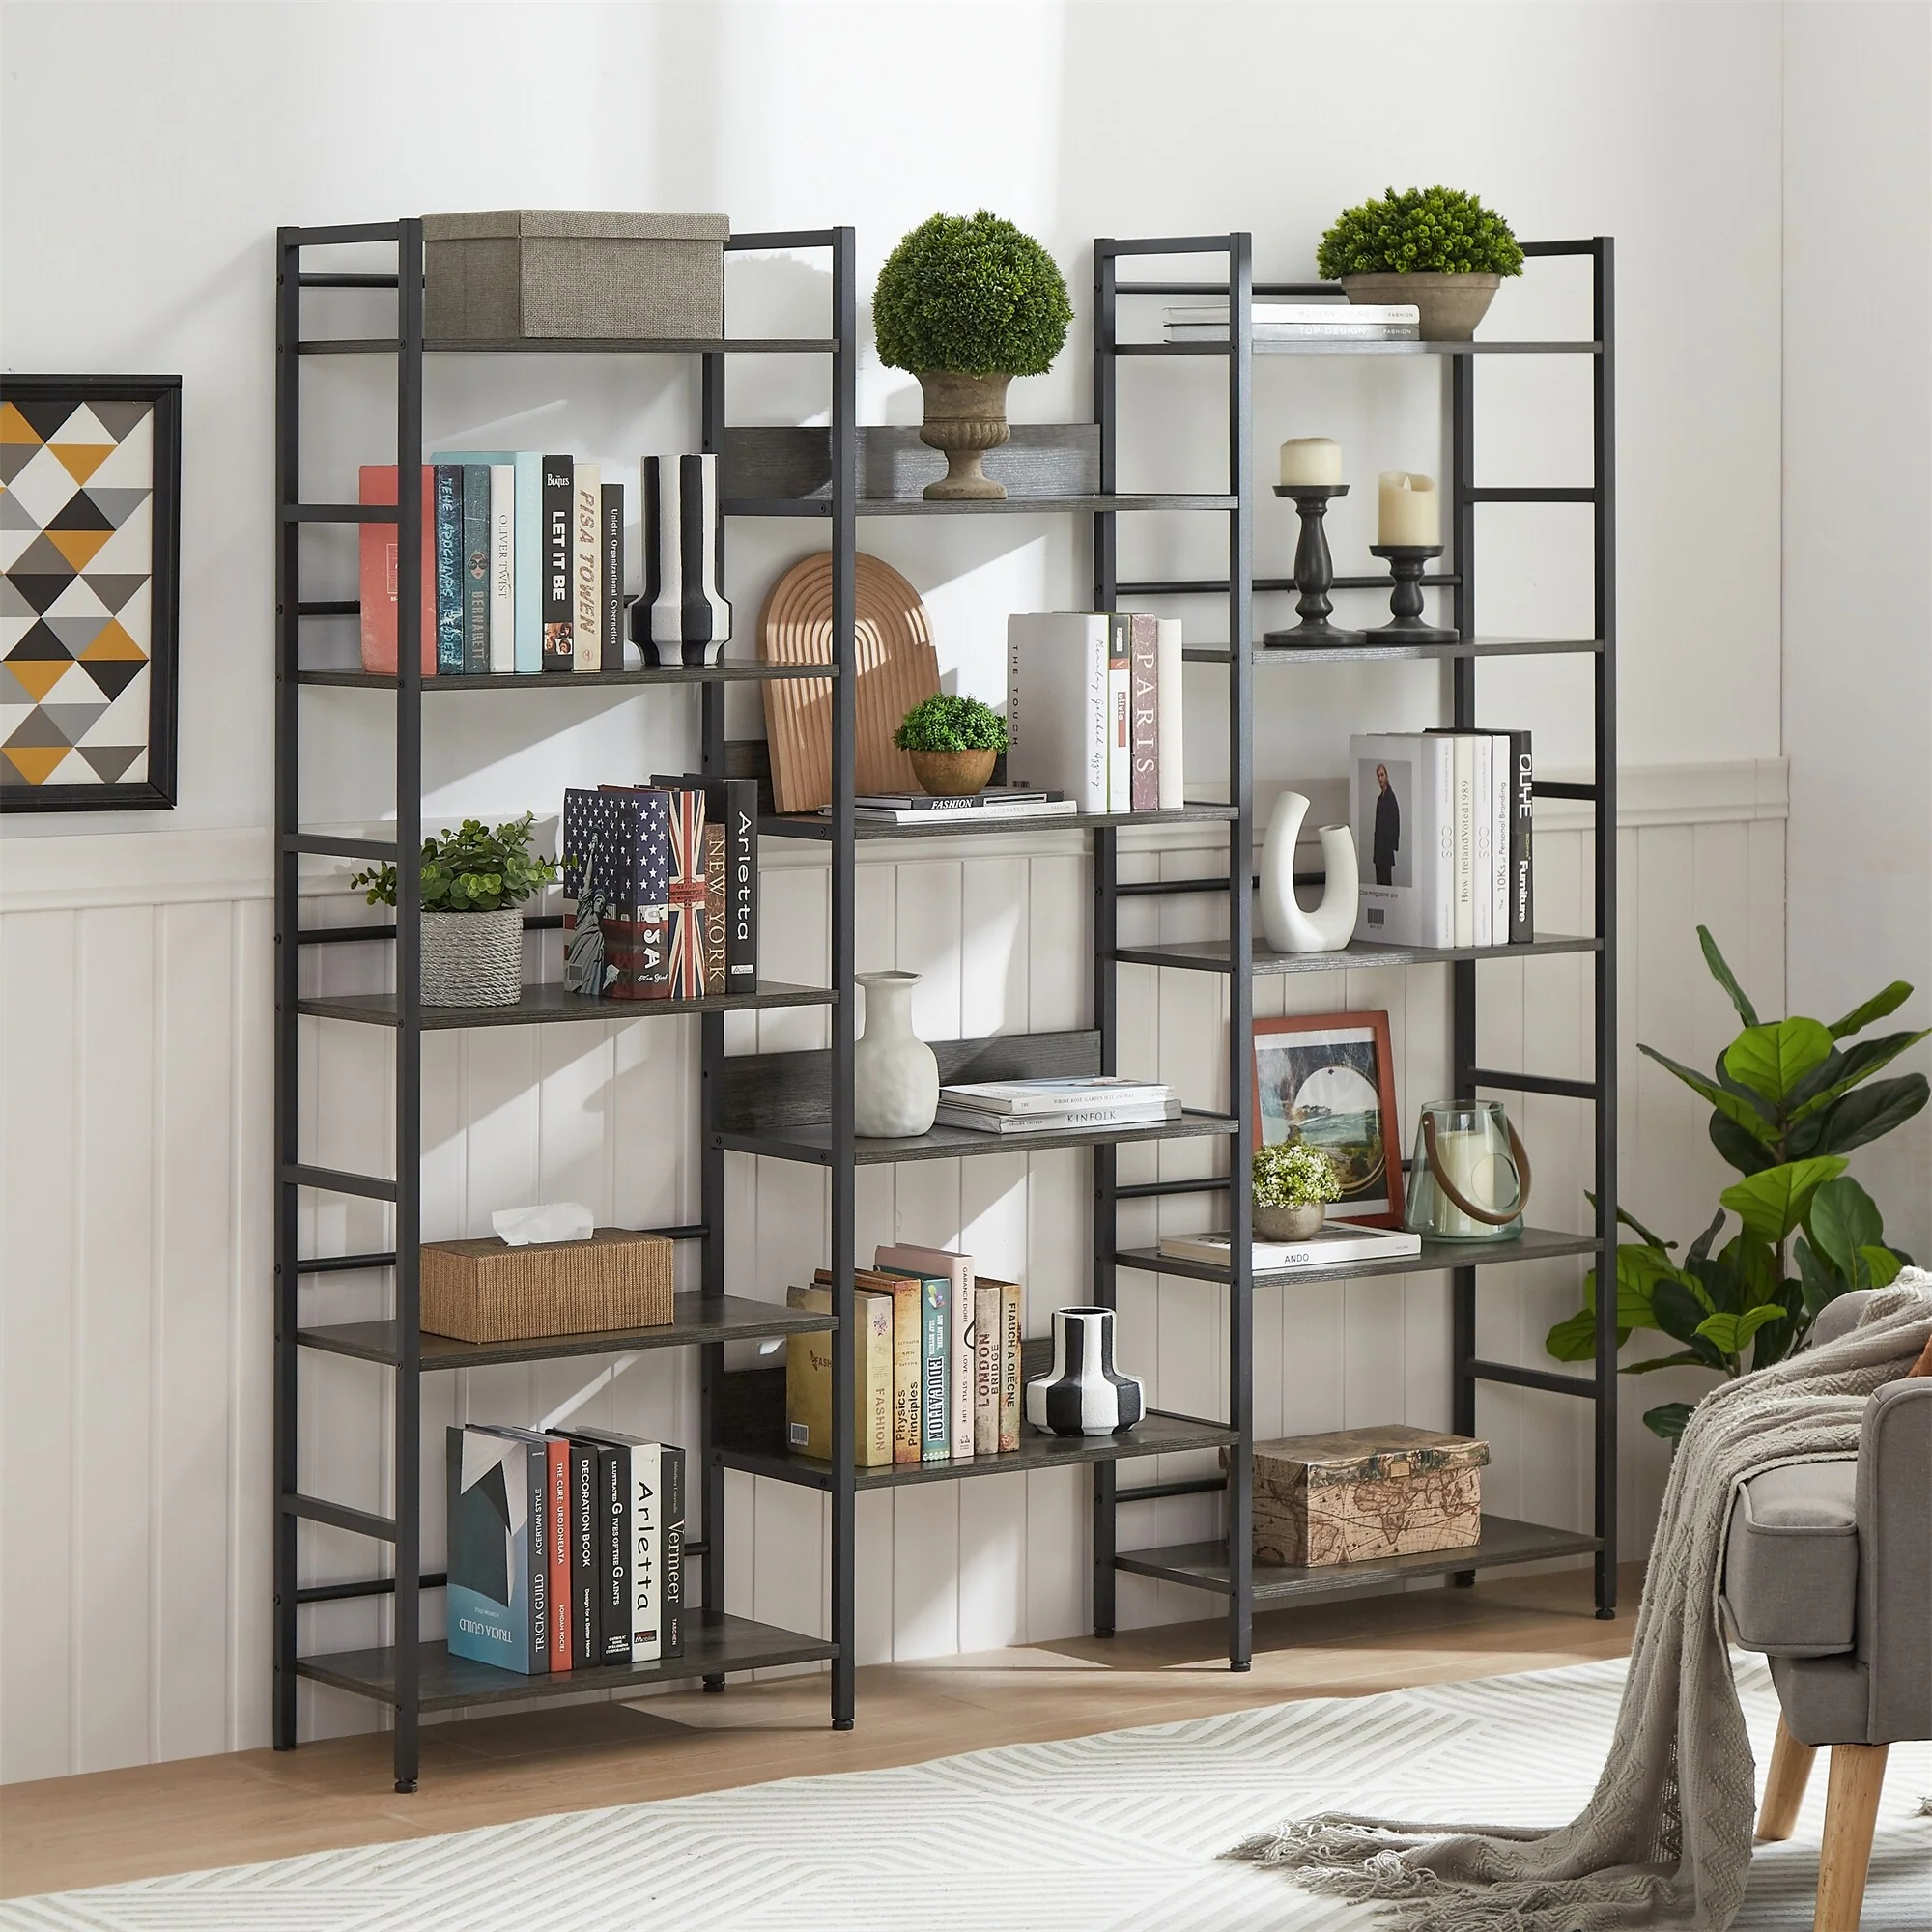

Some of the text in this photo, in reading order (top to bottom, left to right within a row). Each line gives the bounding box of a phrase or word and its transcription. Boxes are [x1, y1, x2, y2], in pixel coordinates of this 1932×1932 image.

[1299, 327, 1367, 335] TOP DESIGN
[547, 472, 570, 488] BEATLES
[579, 489, 595, 544] PISA
[498, 514, 509, 599] OLIVER TWIST
[552, 511, 566, 602] LET IT BE
[609, 542, 618, 596] Organizational
[609, 599, 618, 645] Cybernetics
[1135, 652, 1155, 774] PARIS
[930, 798, 974, 810] FASHION
[1498, 782, 1507, 818] Branding
[736, 810, 752, 942] Arletta
[1461, 880, 1469, 903] How
[1497, 864, 1507, 892] 10Ks
[1519, 860, 1529, 923] Furniture
[708, 838, 725, 982] NEW YORK
[1066, 1109, 1117, 1123] KINFOLK
[1284, 1253, 1310, 1264] ANDO
[978, 1333, 991, 1408] LONDON
[875, 1387, 885, 1451] FASHION
[895, 1389, 906, 1441] Physics
[908, 1381, 919, 1447] Principles
[927, 1356, 944, 1442] EDUCATION
[581, 1459, 591, 1567] DECORATION BOOK
[536, 1548, 543, 1557] A
[612, 1537, 619, 1548] OF
[636, 1481, 655, 1611] Arletta
[668, 1519, 685, 1604] Vermeer
[459, 1618, 513, 1643] TRICIA GUILD
[534, 1574, 544, 1652] TRICIA GUILD
